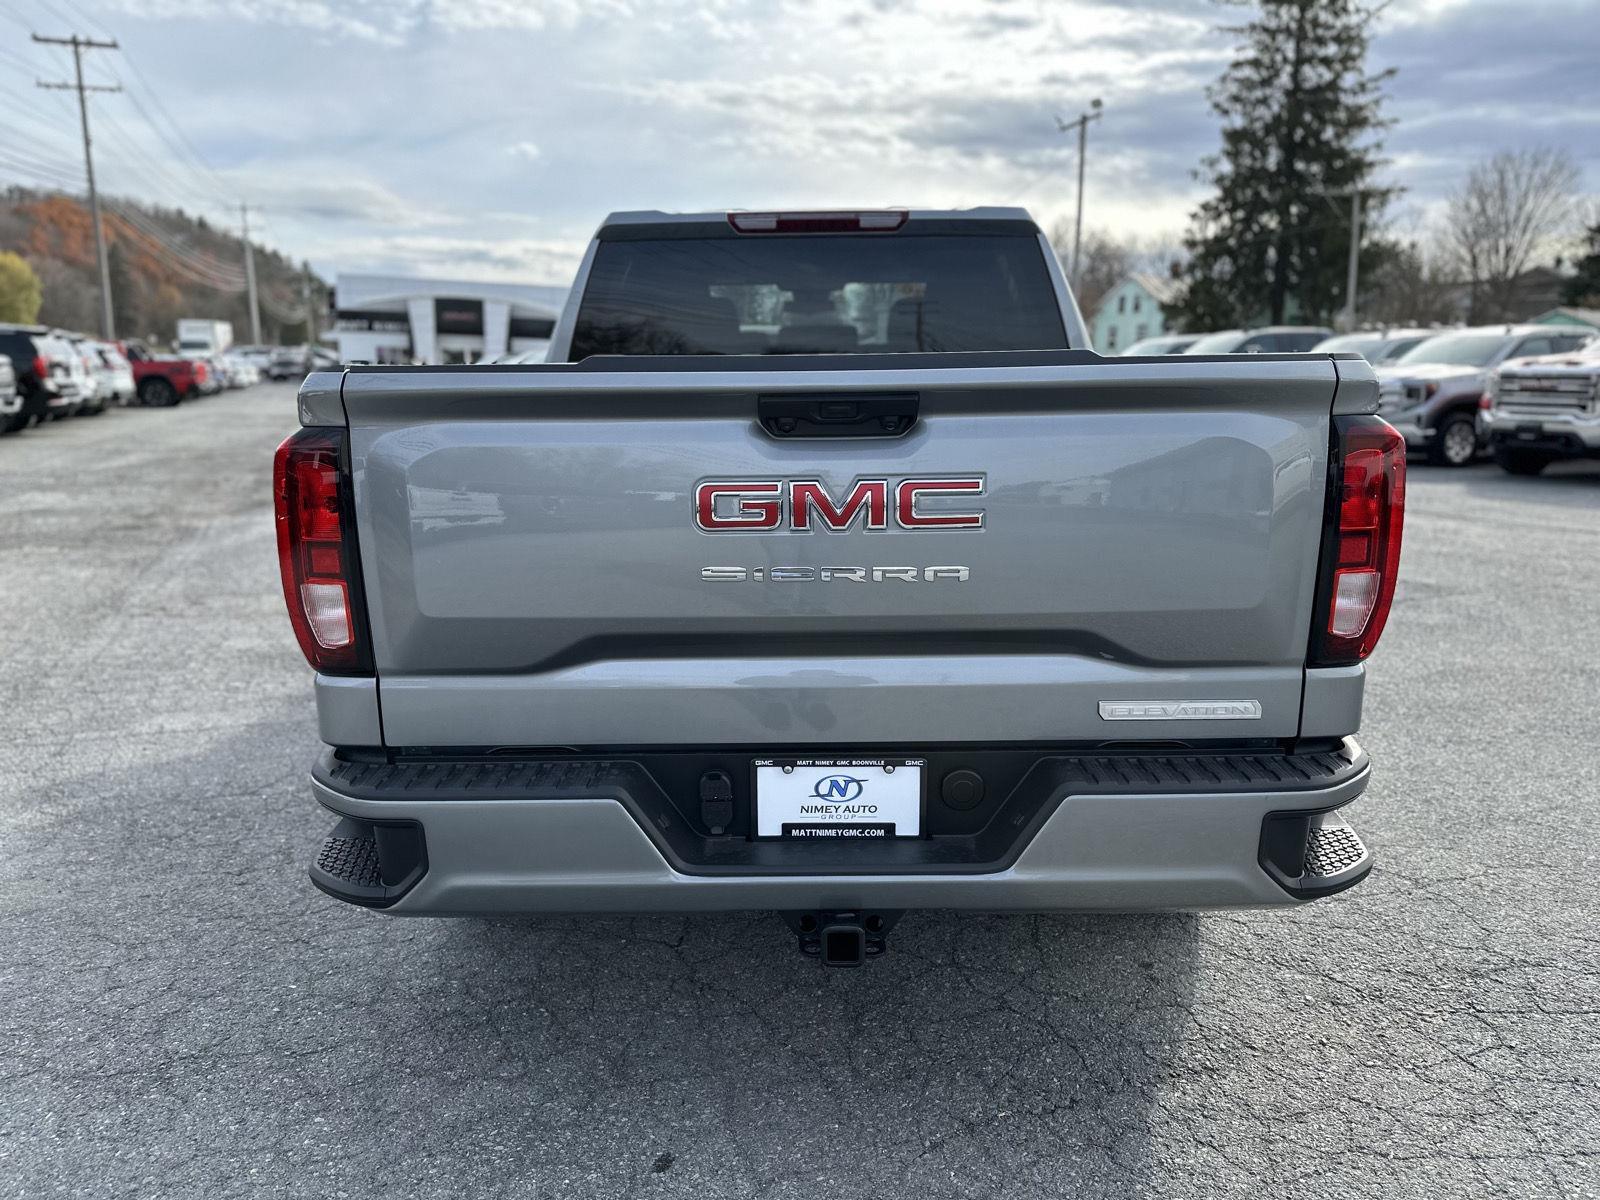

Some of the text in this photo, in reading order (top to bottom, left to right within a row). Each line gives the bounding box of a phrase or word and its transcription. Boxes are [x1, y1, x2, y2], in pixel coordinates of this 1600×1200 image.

[695, 478, 985, 531] GMC
[700, 566, 970, 583] SIERRA
[1109, 705, 1251, 717] ELEVATION
[800, 805, 878, 814] NIMEY AUTO
[791, 829, 885, 837] MATTNIMEYGMC.COM
